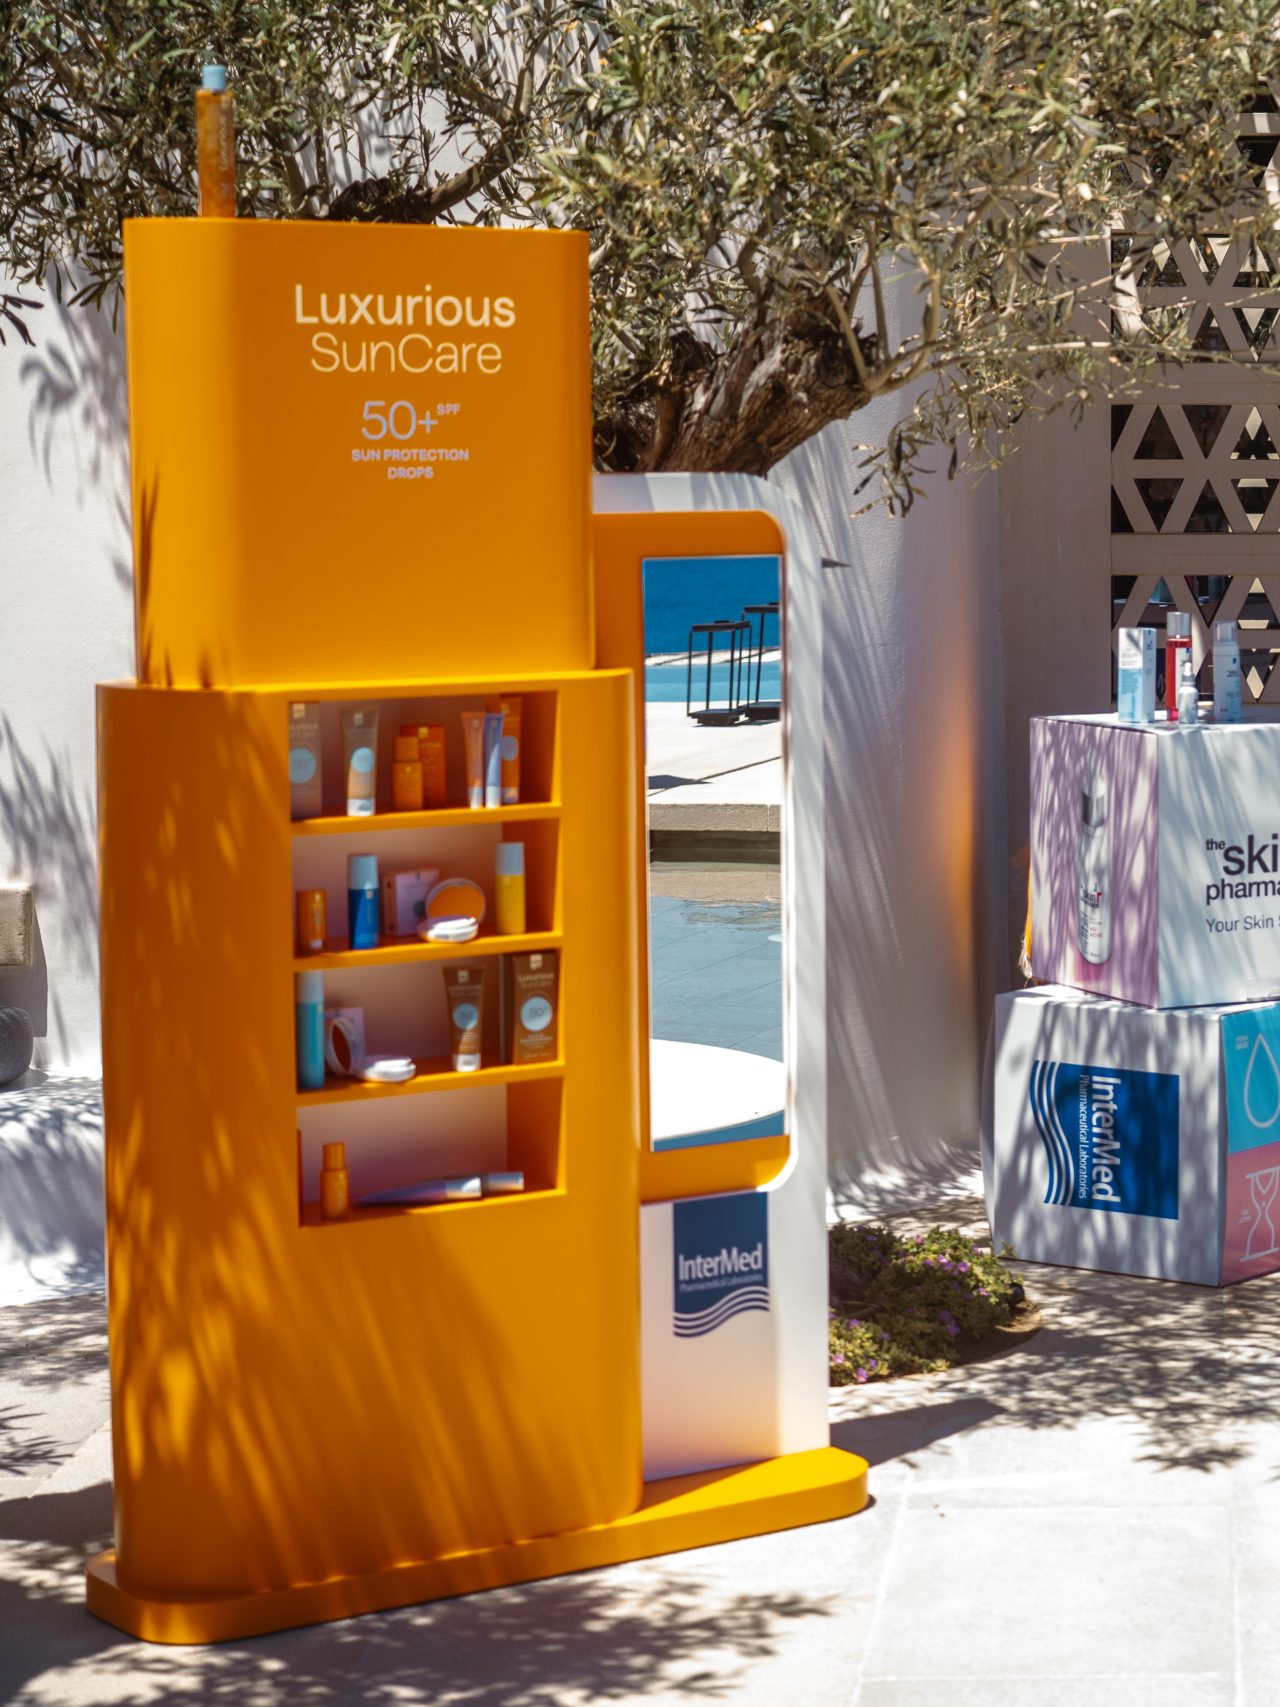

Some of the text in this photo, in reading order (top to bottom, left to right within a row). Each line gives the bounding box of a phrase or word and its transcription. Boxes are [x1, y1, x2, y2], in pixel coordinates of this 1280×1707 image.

[295, 284, 516, 328] Luxurious
[311, 332, 502, 374] SunCare
[361, 400, 461, 440] 50+ SPF
[352, 449, 469, 461] SUN PROTECTION
[388, 466, 434, 479] DROPS
[1205, 838, 1226, 851] the
[1205, 918, 1240, 933] Your
[1243, 914, 1275, 931] Skin
[1078, 1074, 1091, 1199] Pharmaceutical Laboratories
[1092, 1075, 1121, 1202] InterMed
[678, 1242, 763, 1281] InterMed
